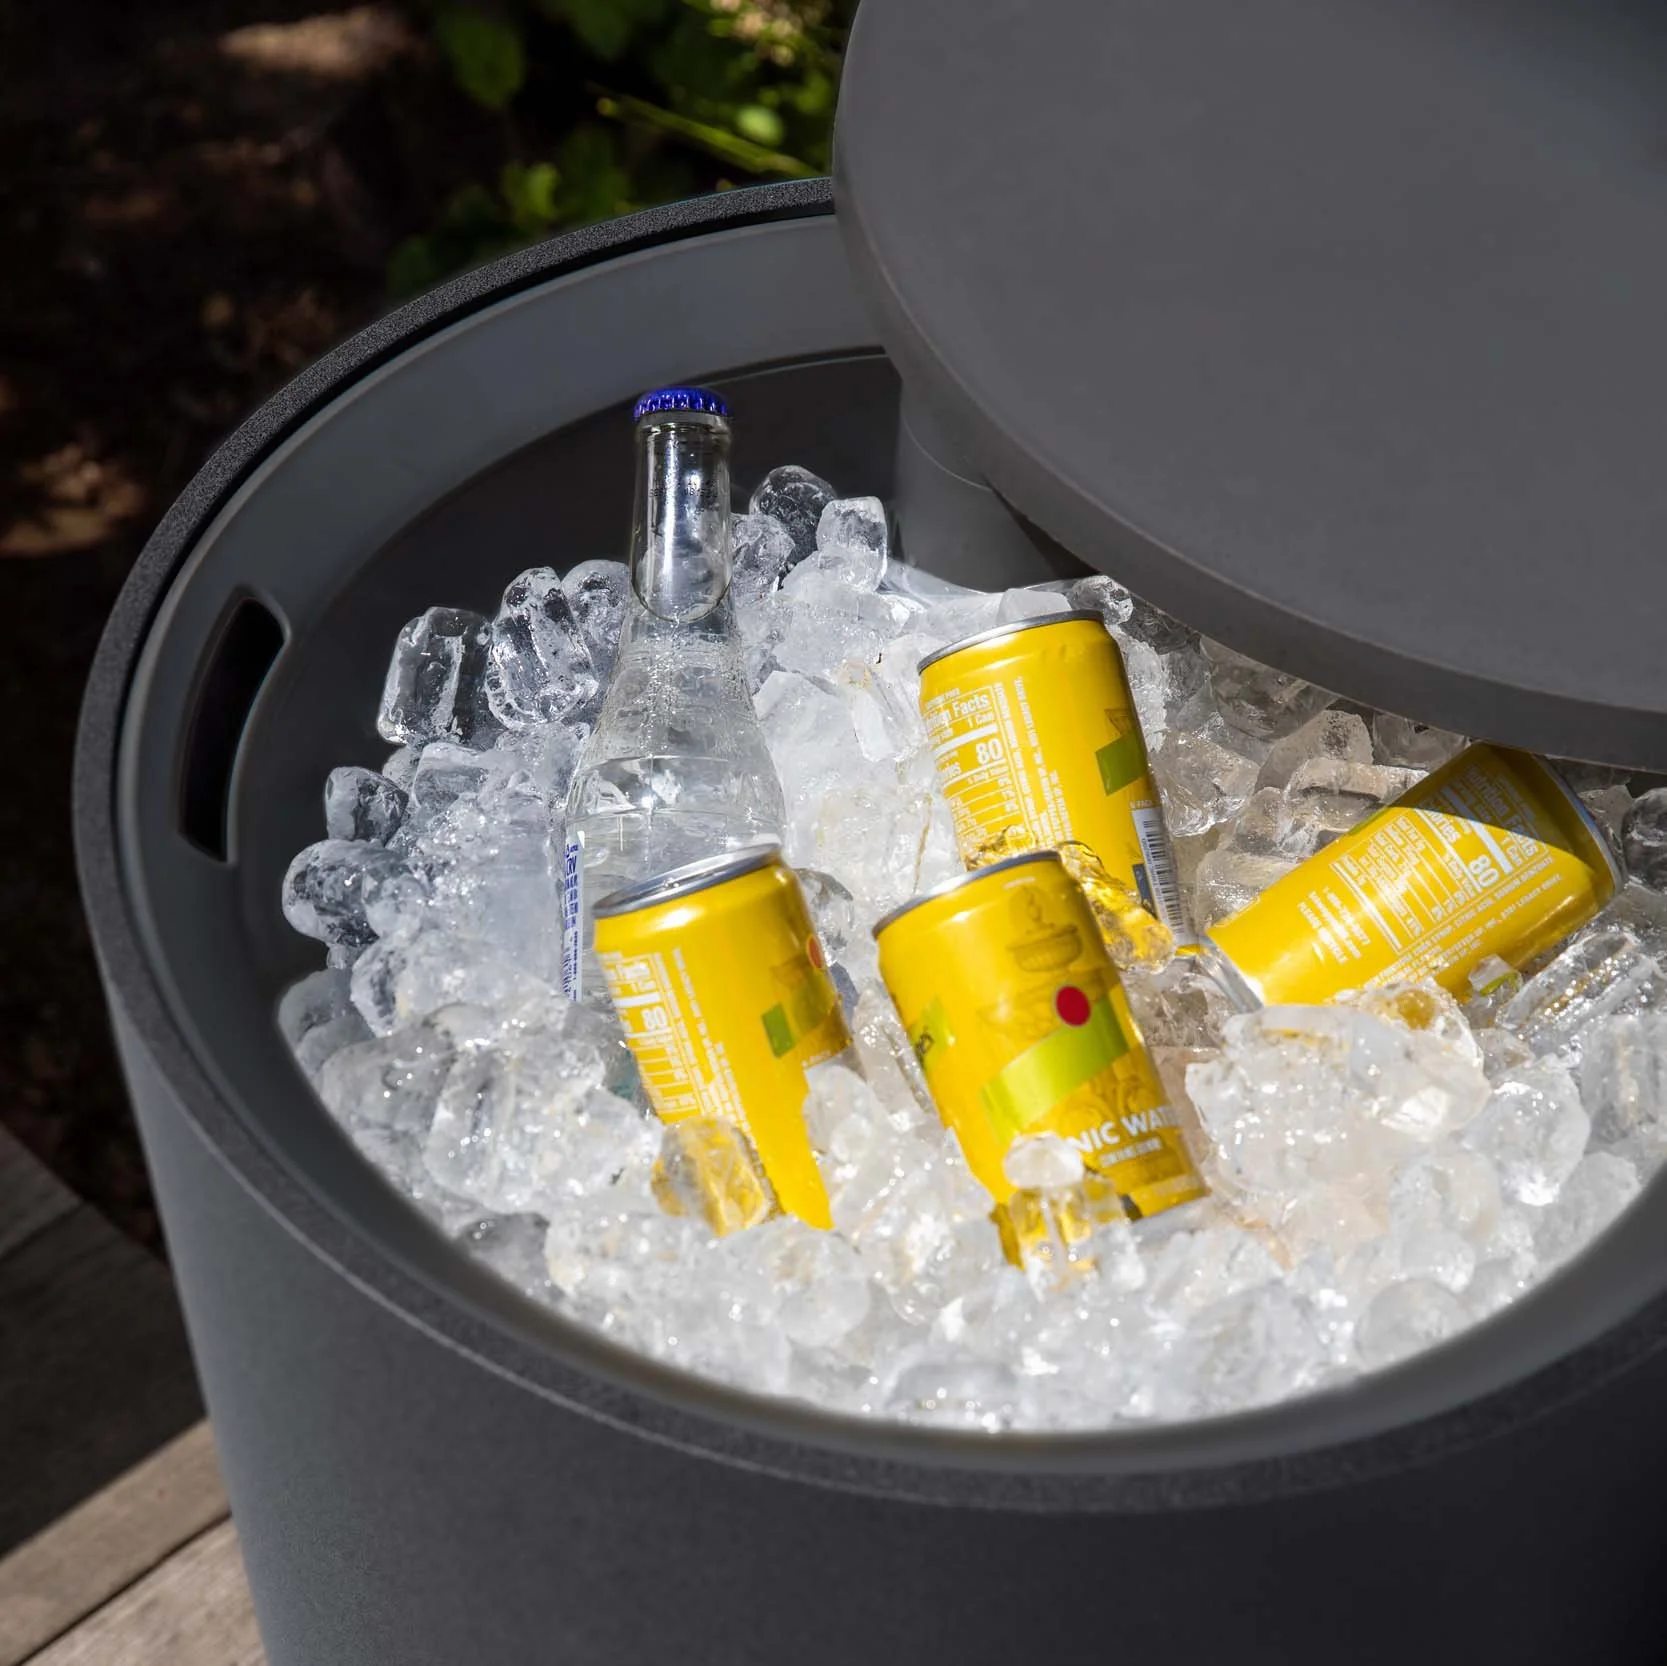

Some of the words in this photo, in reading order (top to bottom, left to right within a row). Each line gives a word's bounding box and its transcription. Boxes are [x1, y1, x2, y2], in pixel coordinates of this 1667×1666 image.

[952, 692, 990, 718] Facts
[975, 737, 1004, 765] 80
[1501, 813, 1540, 859] Facts
[1468, 853, 1500, 888] 80
[640, 1006, 669, 1033] 80
[1066, 1121, 1121, 1154] NIC
